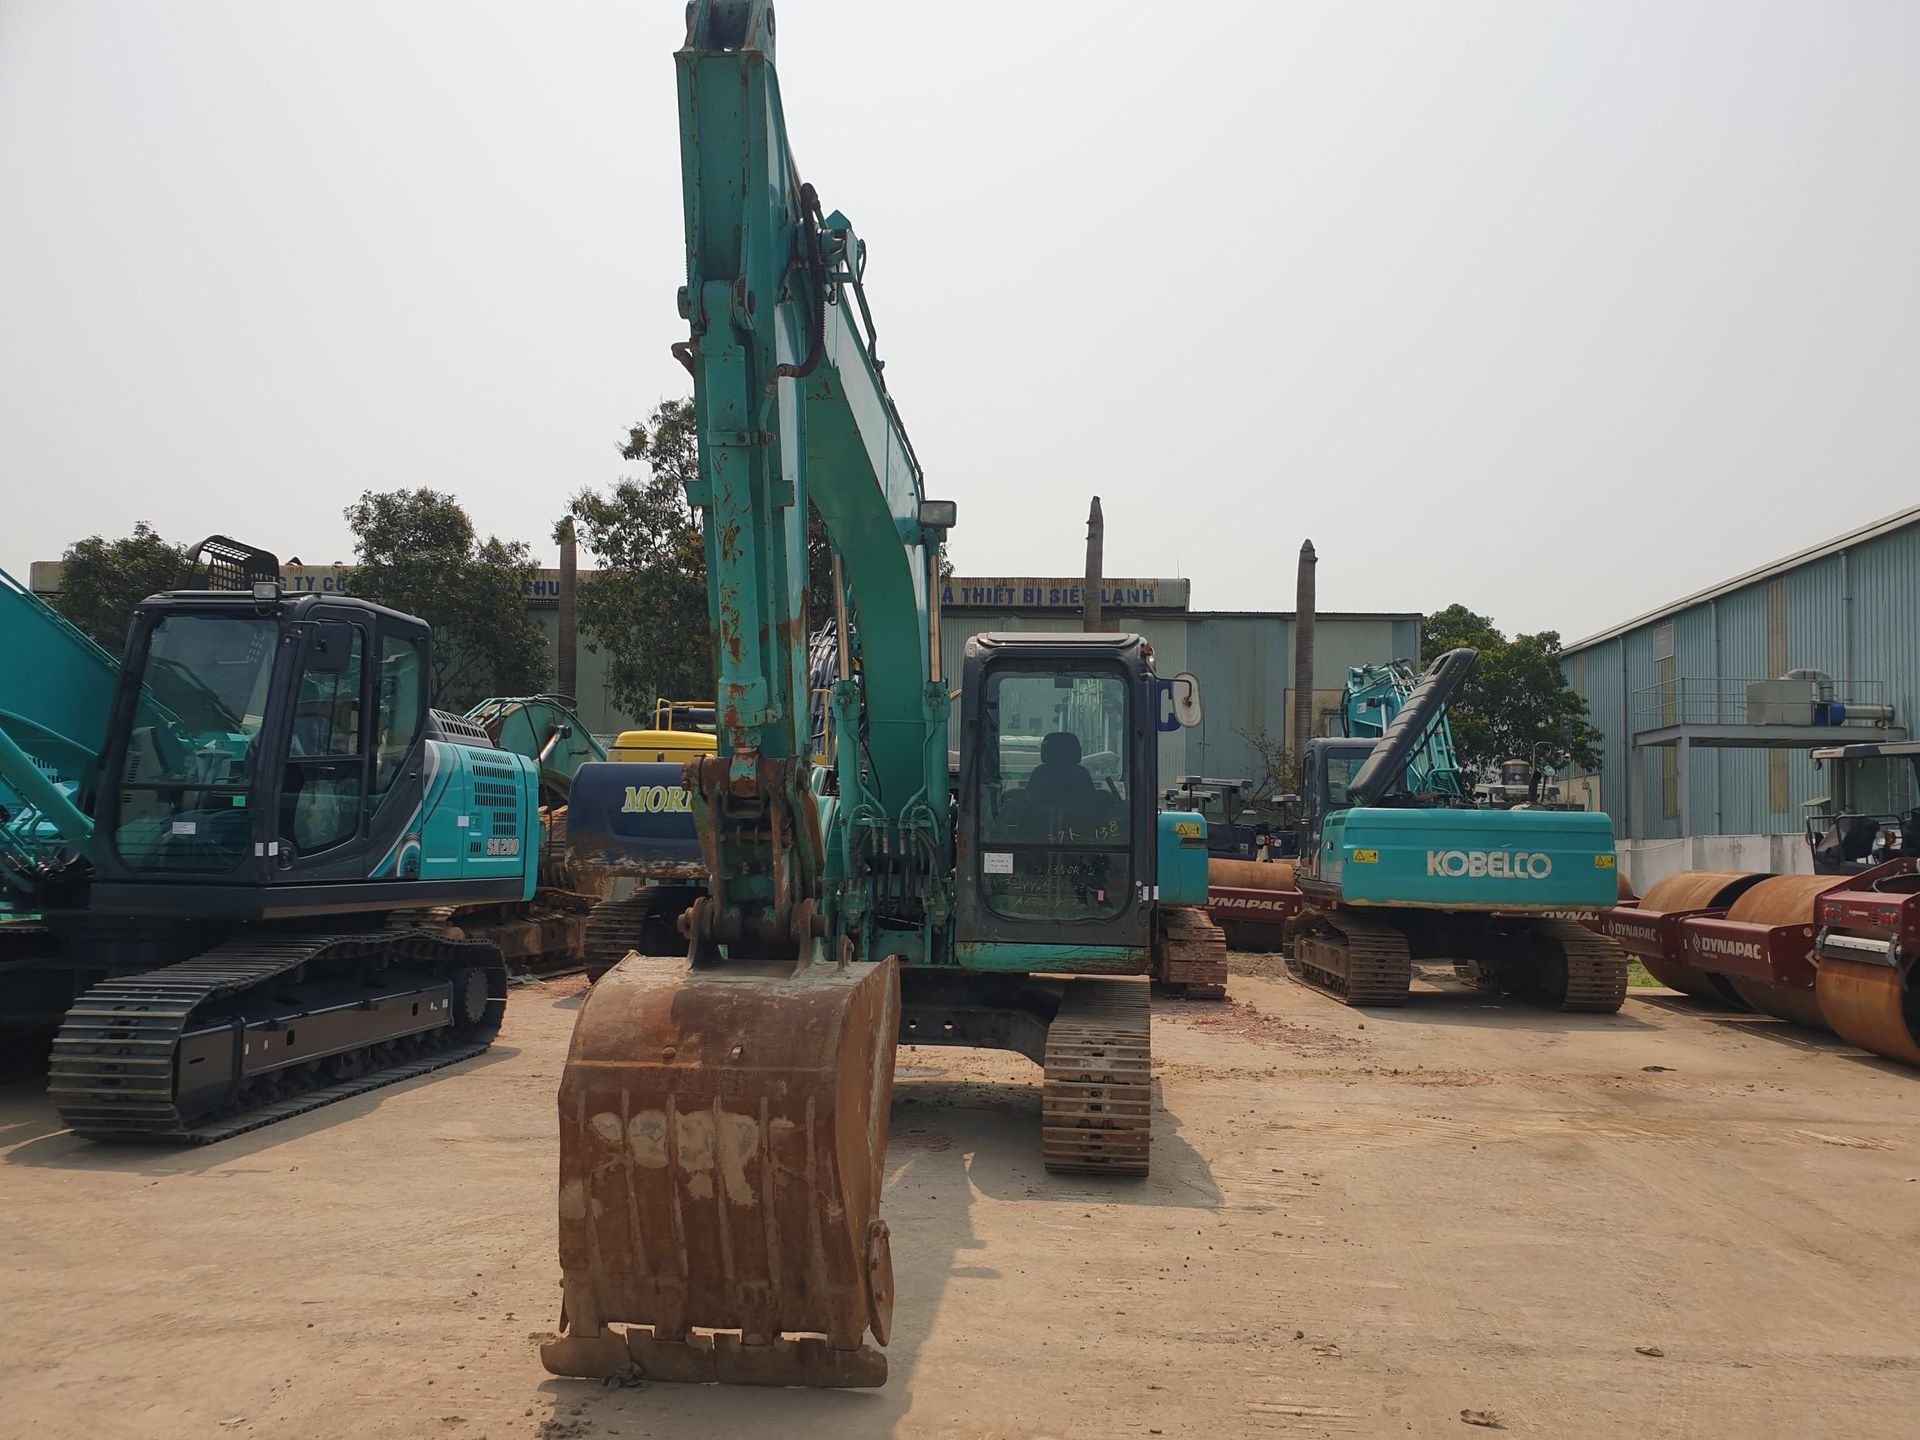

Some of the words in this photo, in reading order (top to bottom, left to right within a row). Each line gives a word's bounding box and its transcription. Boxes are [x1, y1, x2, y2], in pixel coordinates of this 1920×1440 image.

[1049, 585, 1084, 604] SIÊ
[1426, 850, 1553, 879] KOBELCO
[1207, 896, 1285, 911] YNAPAC
[1615, 923, 1657, 942] DYNAPAC
[1701, 936, 1762, 960] DYNAPAC
